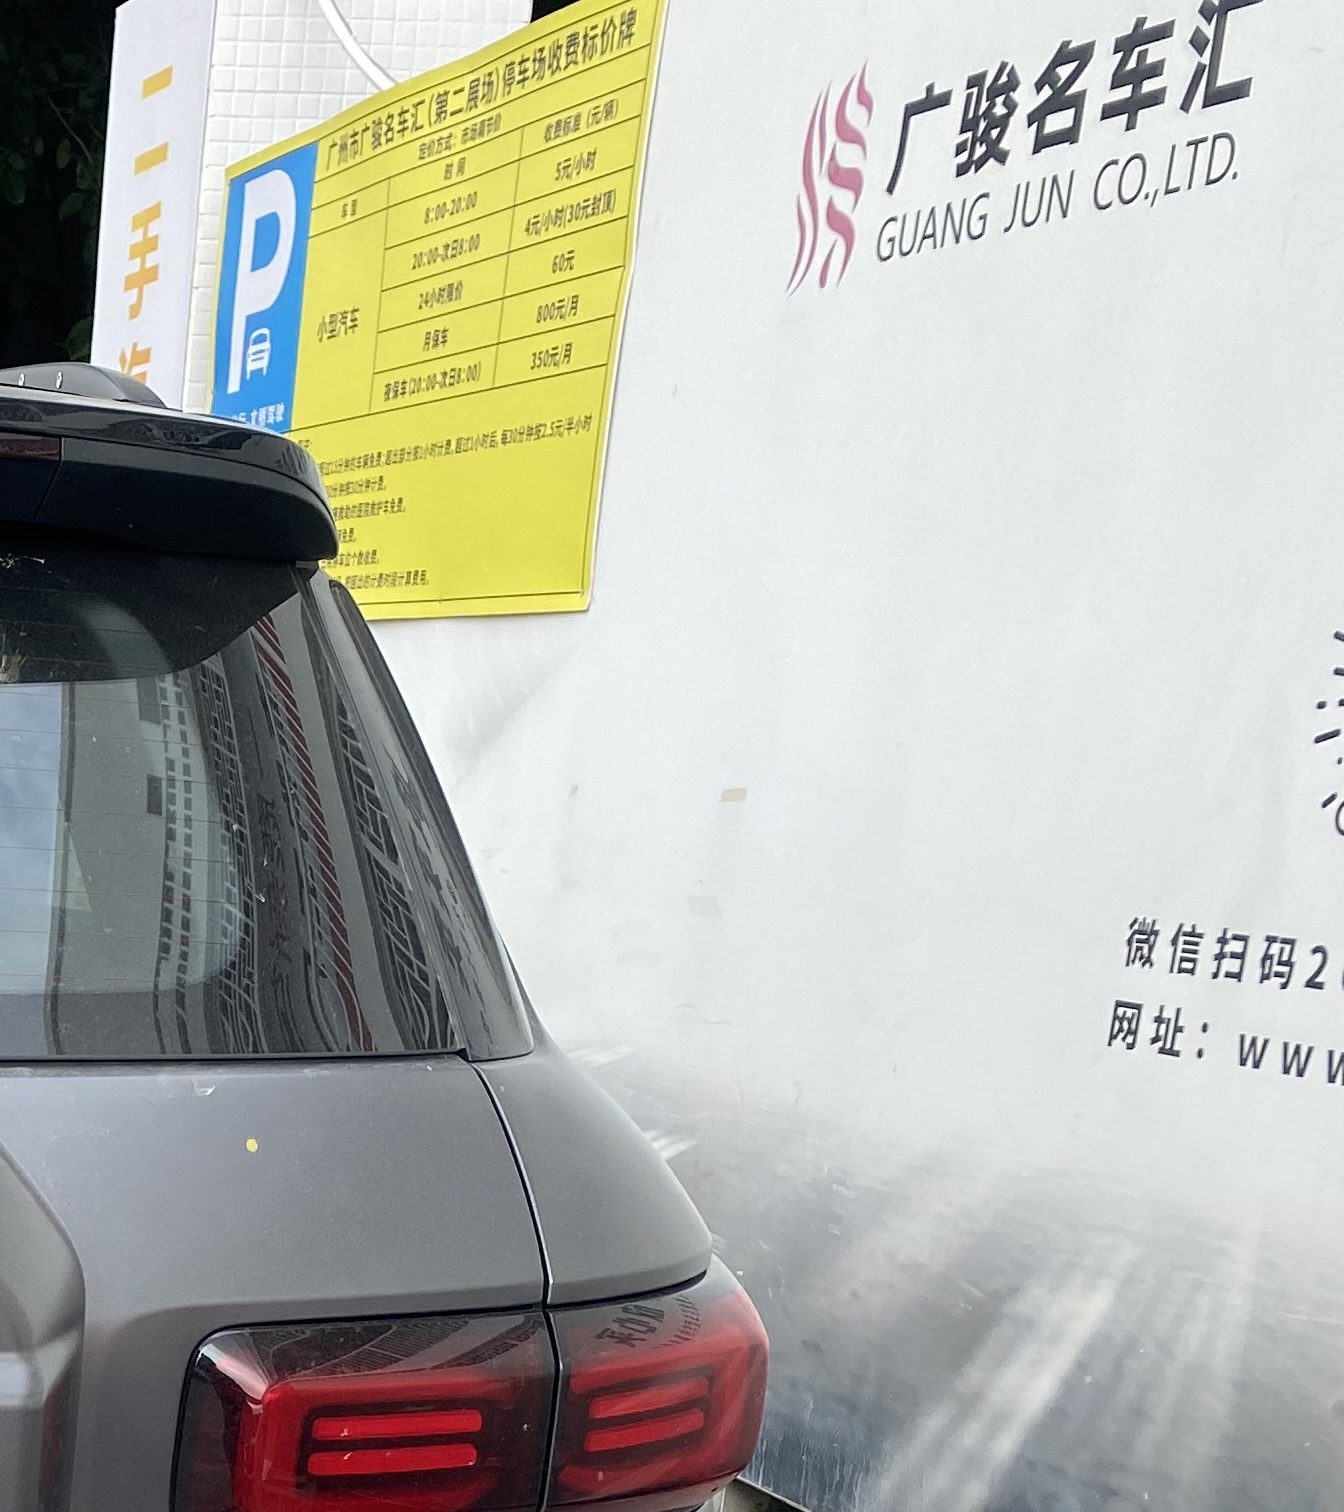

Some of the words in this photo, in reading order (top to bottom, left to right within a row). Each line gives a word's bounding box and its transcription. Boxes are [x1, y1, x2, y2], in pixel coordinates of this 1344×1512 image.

[884, 0, 1263, 195] 广骏名车汇
[876, 192, 991, 262] GUANG
[1003, 169, 1075, 233] JUN
[551, 250, 576, 273] 60元
[227, 169, 297, 394] P
[317, 305, 360, 343] 小型汽车
[536, 294, 580, 323] 800元/月
[423, 327, 449, 352] 月保车
[530, 343, 573, 370] 350元/月
